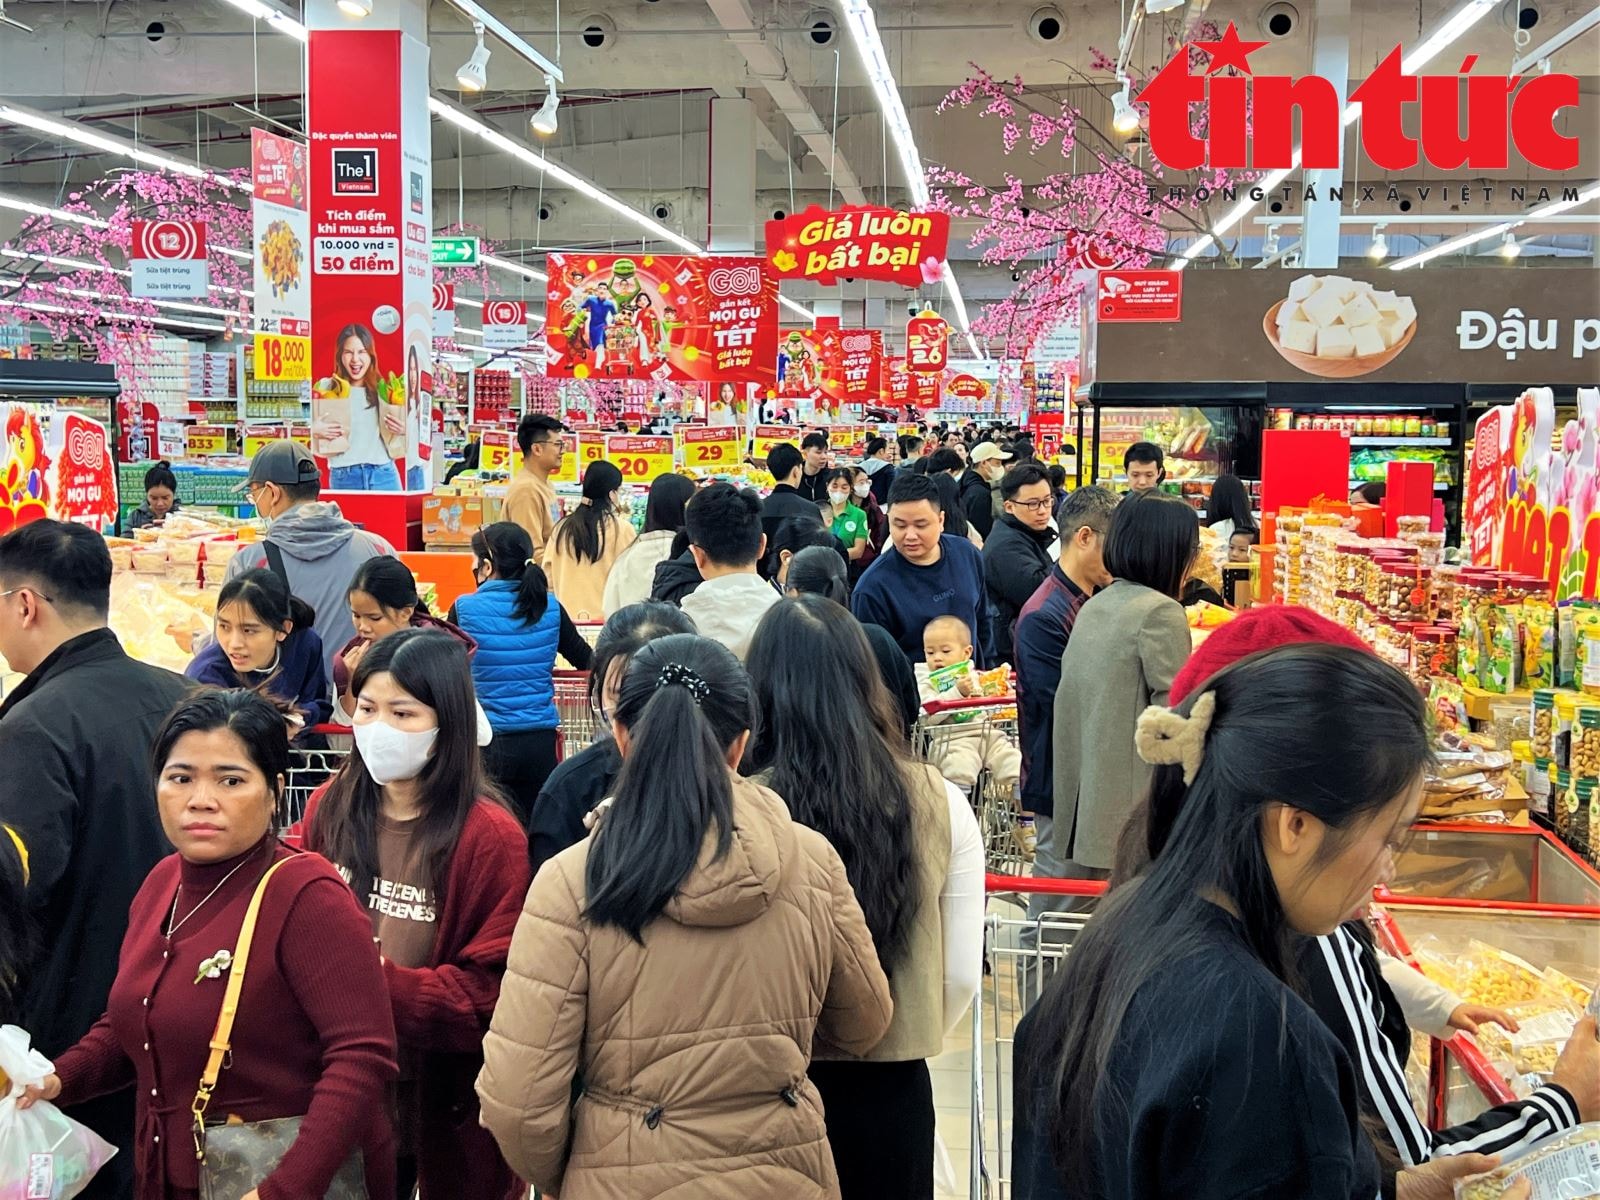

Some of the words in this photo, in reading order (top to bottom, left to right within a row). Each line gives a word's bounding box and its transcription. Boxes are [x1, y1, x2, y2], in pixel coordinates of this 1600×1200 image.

[312, 132, 328, 140] Đặc
[356, 132, 378, 140] thành
[326, 210, 352, 220] Tích
[356, 208, 386, 220] điểm
[318, 223, 336, 234] khi
[340, 226, 366, 234] mua
[369, 222, 394, 234] sắm
[799, 214, 853, 246] Giá
[859, 210, 932, 236] luôn
[158, 233, 180, 250] 12
[320, 240, 360, 250] 10.000
[363, 241, 384, 250] vnd
[322, 256, 344, 270] 50
[350, 252, 394, 270] điểm
[805, 241, 862, 276] bất
[868, 241, 921, 271] bại
[709, 267, 760, 296] GO!
[710, 310, 736, 322] MỌI
[739, 306, 760, 320] GU
[714, 322, 756, 348] TẾT
[1457, 308, 1556, 360] Đậu
[845, 367, 869, 380] TẾT
[188, 438, 214, 449] 833
[832, 434, 844, 443] 67
[69, 426, 103, 470] GO!
[697, 446, 722, 460] 29
[618, 458, 648, 476] 20
[68, 487, 86, 506] MỌI
[87, 486, 102, 500] GU
[1474, 509, 1493, 556] TẾT
